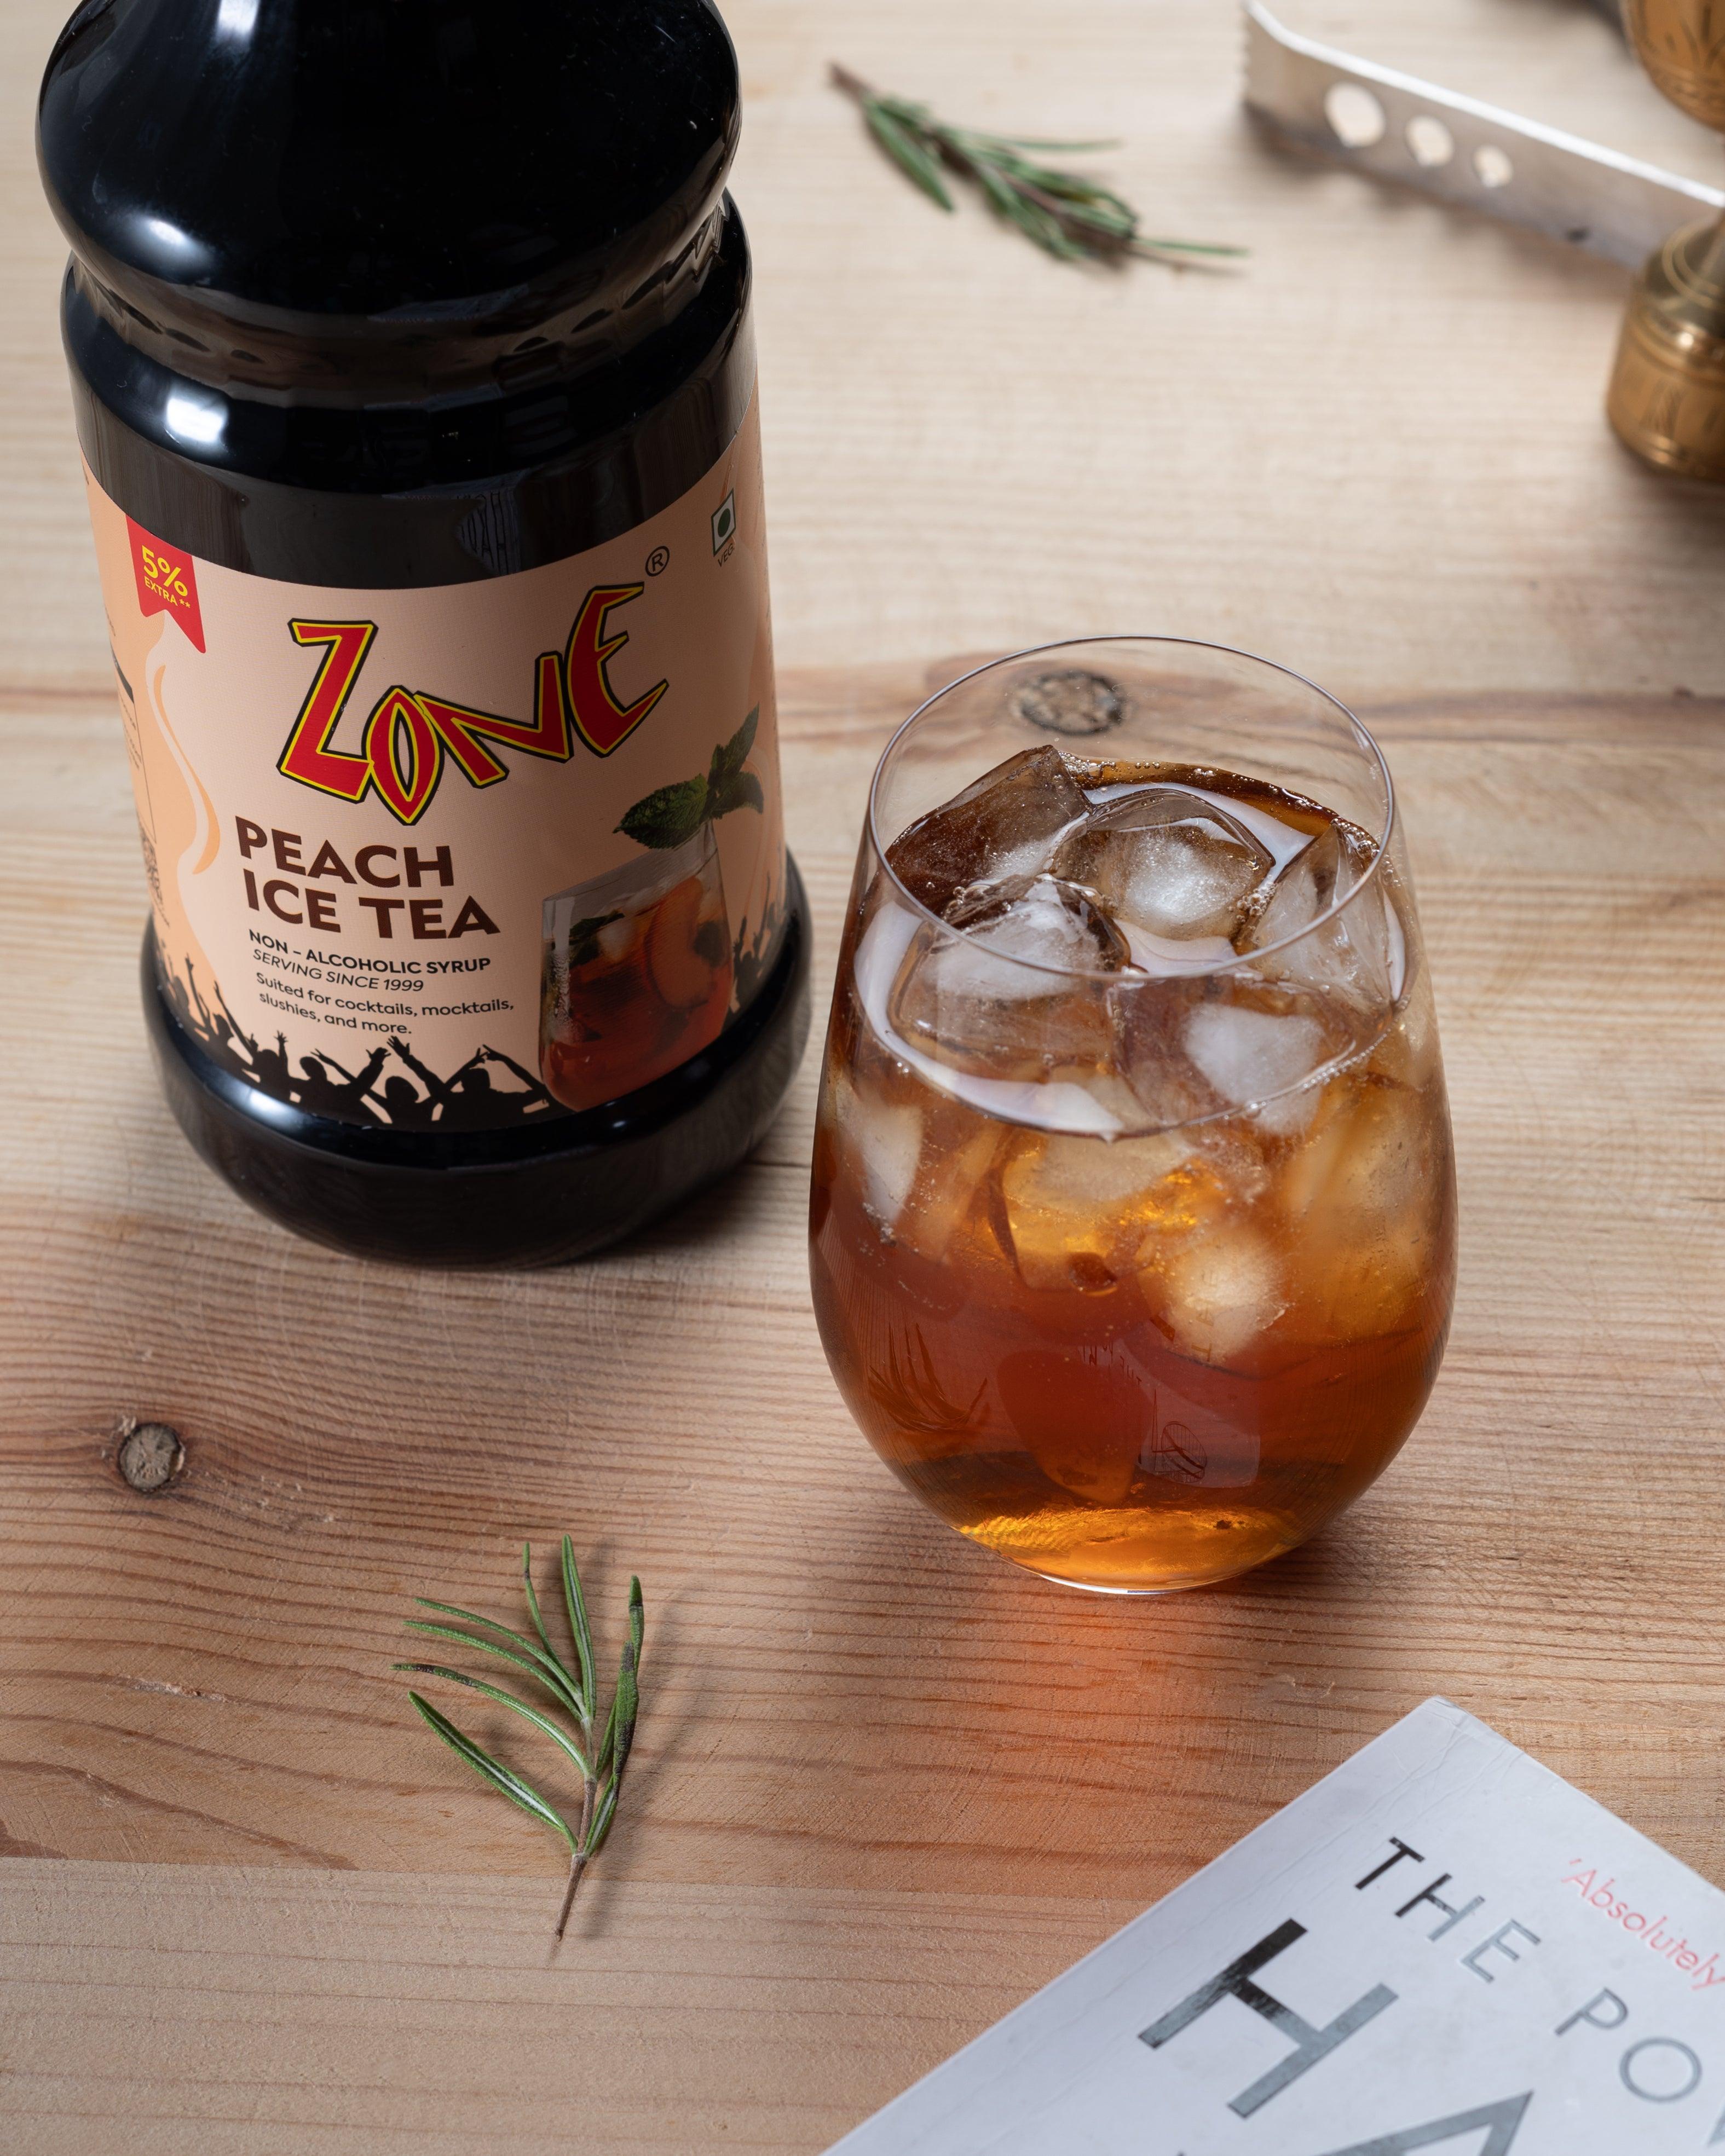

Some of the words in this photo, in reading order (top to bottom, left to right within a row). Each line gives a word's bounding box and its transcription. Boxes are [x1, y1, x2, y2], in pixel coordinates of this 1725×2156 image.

[142, 545, 188, 597] 5%
[717, 542, 735, 567] VEG
[276, 581, 670, 826] ZONE
[235, 816, 454, 888] PEACH
[243, 868, 341, 933] ICE
[358, 895, 501, 939] TEA
[249, 929, 288, 954] NON
[306, 949, 422, 974] ALCOHOLIC
[426, 958, 491, 974] SYRUP
[253, 949, 322, 979] SERVING
[326, 972, 379, 989] SINCE
[383, 979, 424, 992] 1999
[256, 972, 304, 999] Suited
[307, 989, 332, 1005] for
[335, 998, 418, 1017] cocktails,
[422, 999, 514, 1016] mocktails,
[259, 993, 321, 1022] slushies,
[325, 1015, 357, 1028] and
[361, 1021, 412, 1034] more.
[1354, 1836, 1542, 1984] THE
[1554, 1987, 1725, 2148] PO
